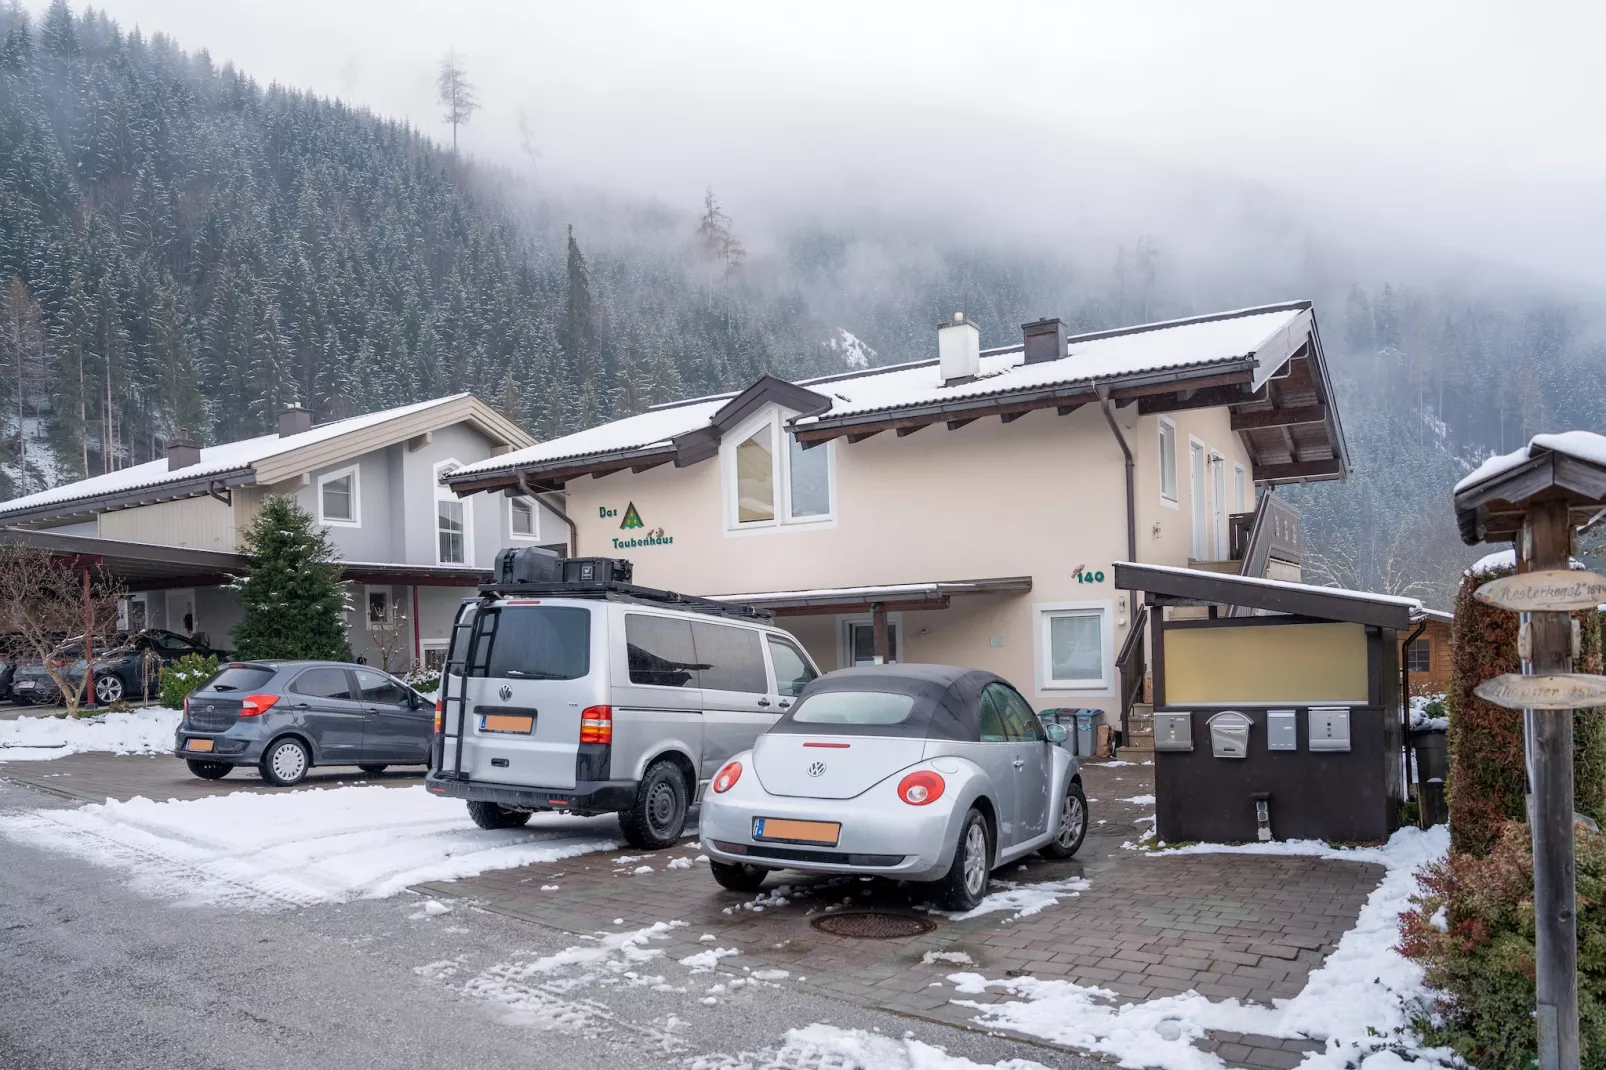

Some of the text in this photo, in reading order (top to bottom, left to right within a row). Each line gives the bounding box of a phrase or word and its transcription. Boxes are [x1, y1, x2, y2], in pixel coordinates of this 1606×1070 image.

[599, 506, 617, 518] Das
[612, 536, 673, 549] Taubenhaus
[1077, 571, 1105, 584] 140
